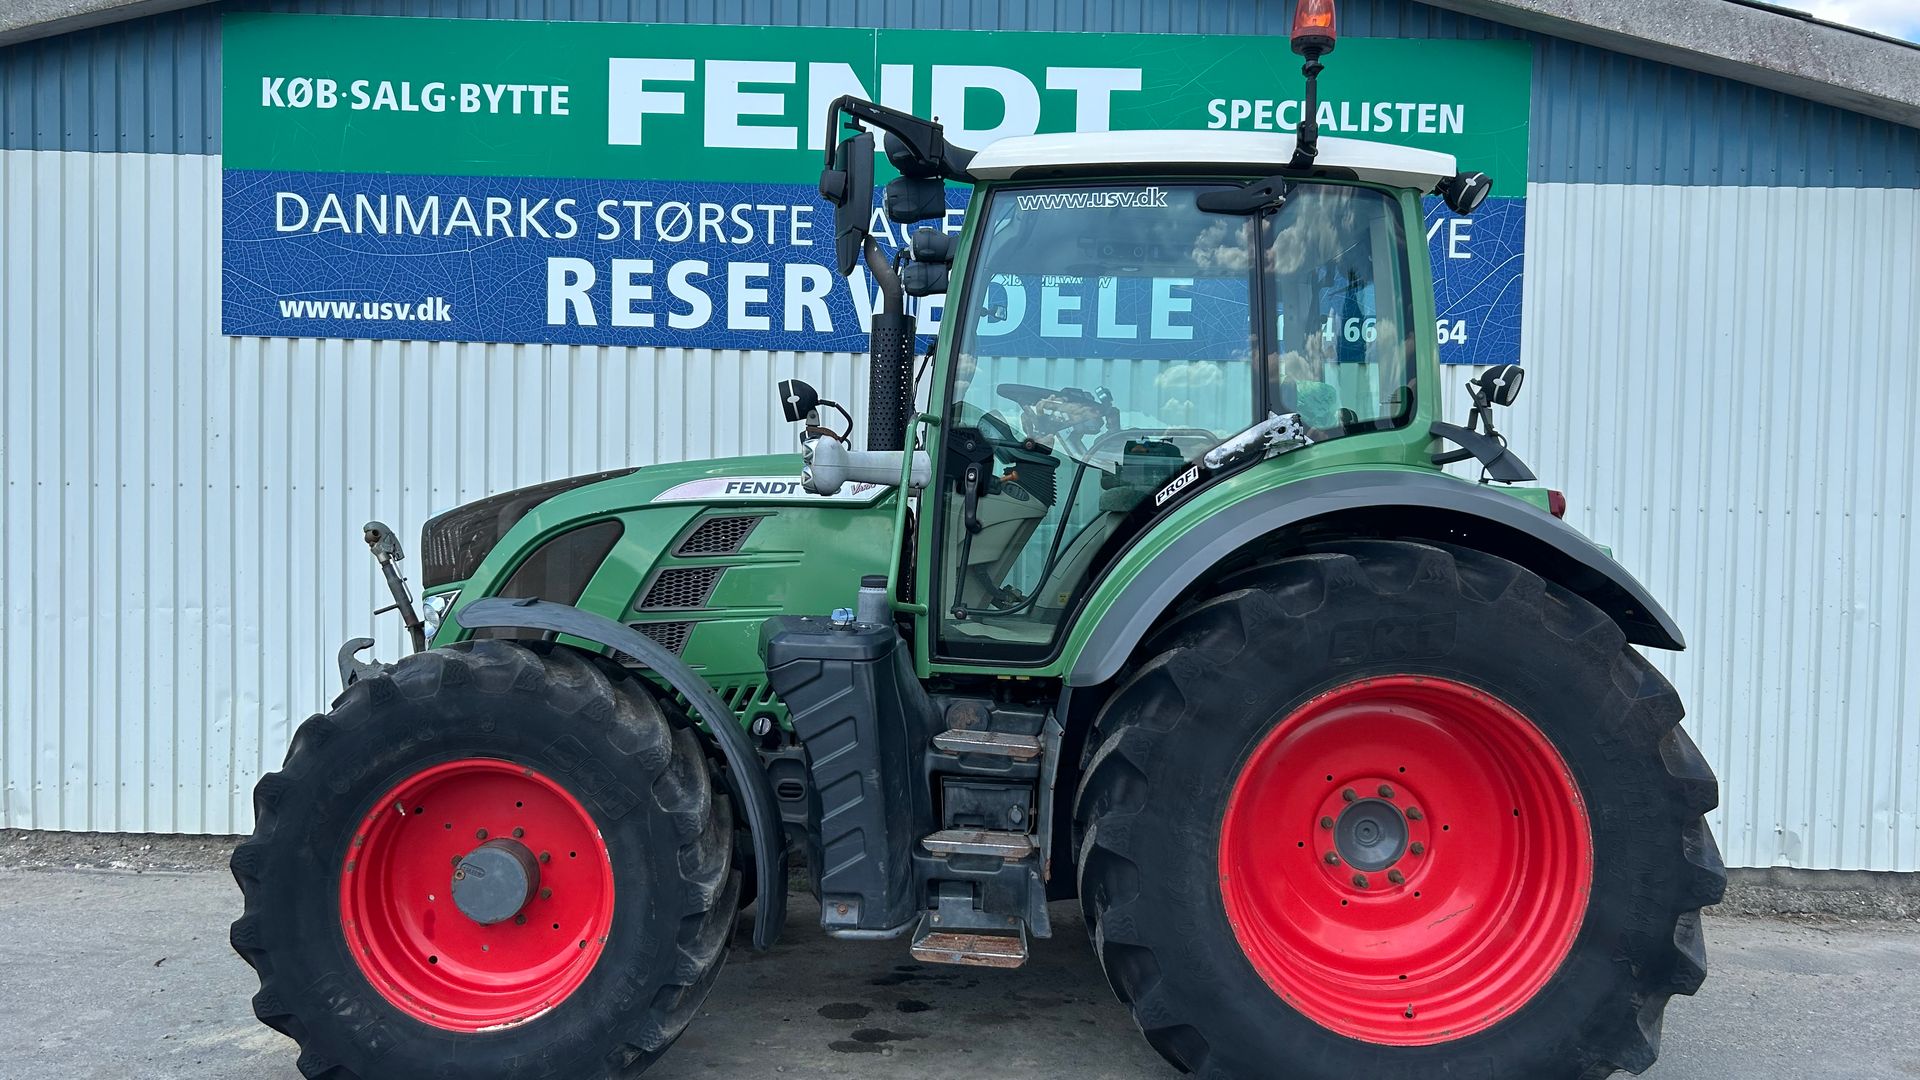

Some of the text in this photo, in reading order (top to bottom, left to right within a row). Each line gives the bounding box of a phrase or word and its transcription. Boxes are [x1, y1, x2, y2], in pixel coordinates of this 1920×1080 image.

[608, 57, 1142, 151] FENDT
[1017, 187, 1168, 211] www.usv.dk
[275, 191, 578, 239] DANMARKS
[596, 200, 814, 246] STØRSTE
[279, 297, 452, 323] www.usv.dk
[725, 482, 801, 494] FENDT
[1157, 467, 1197, 503] PROFI
